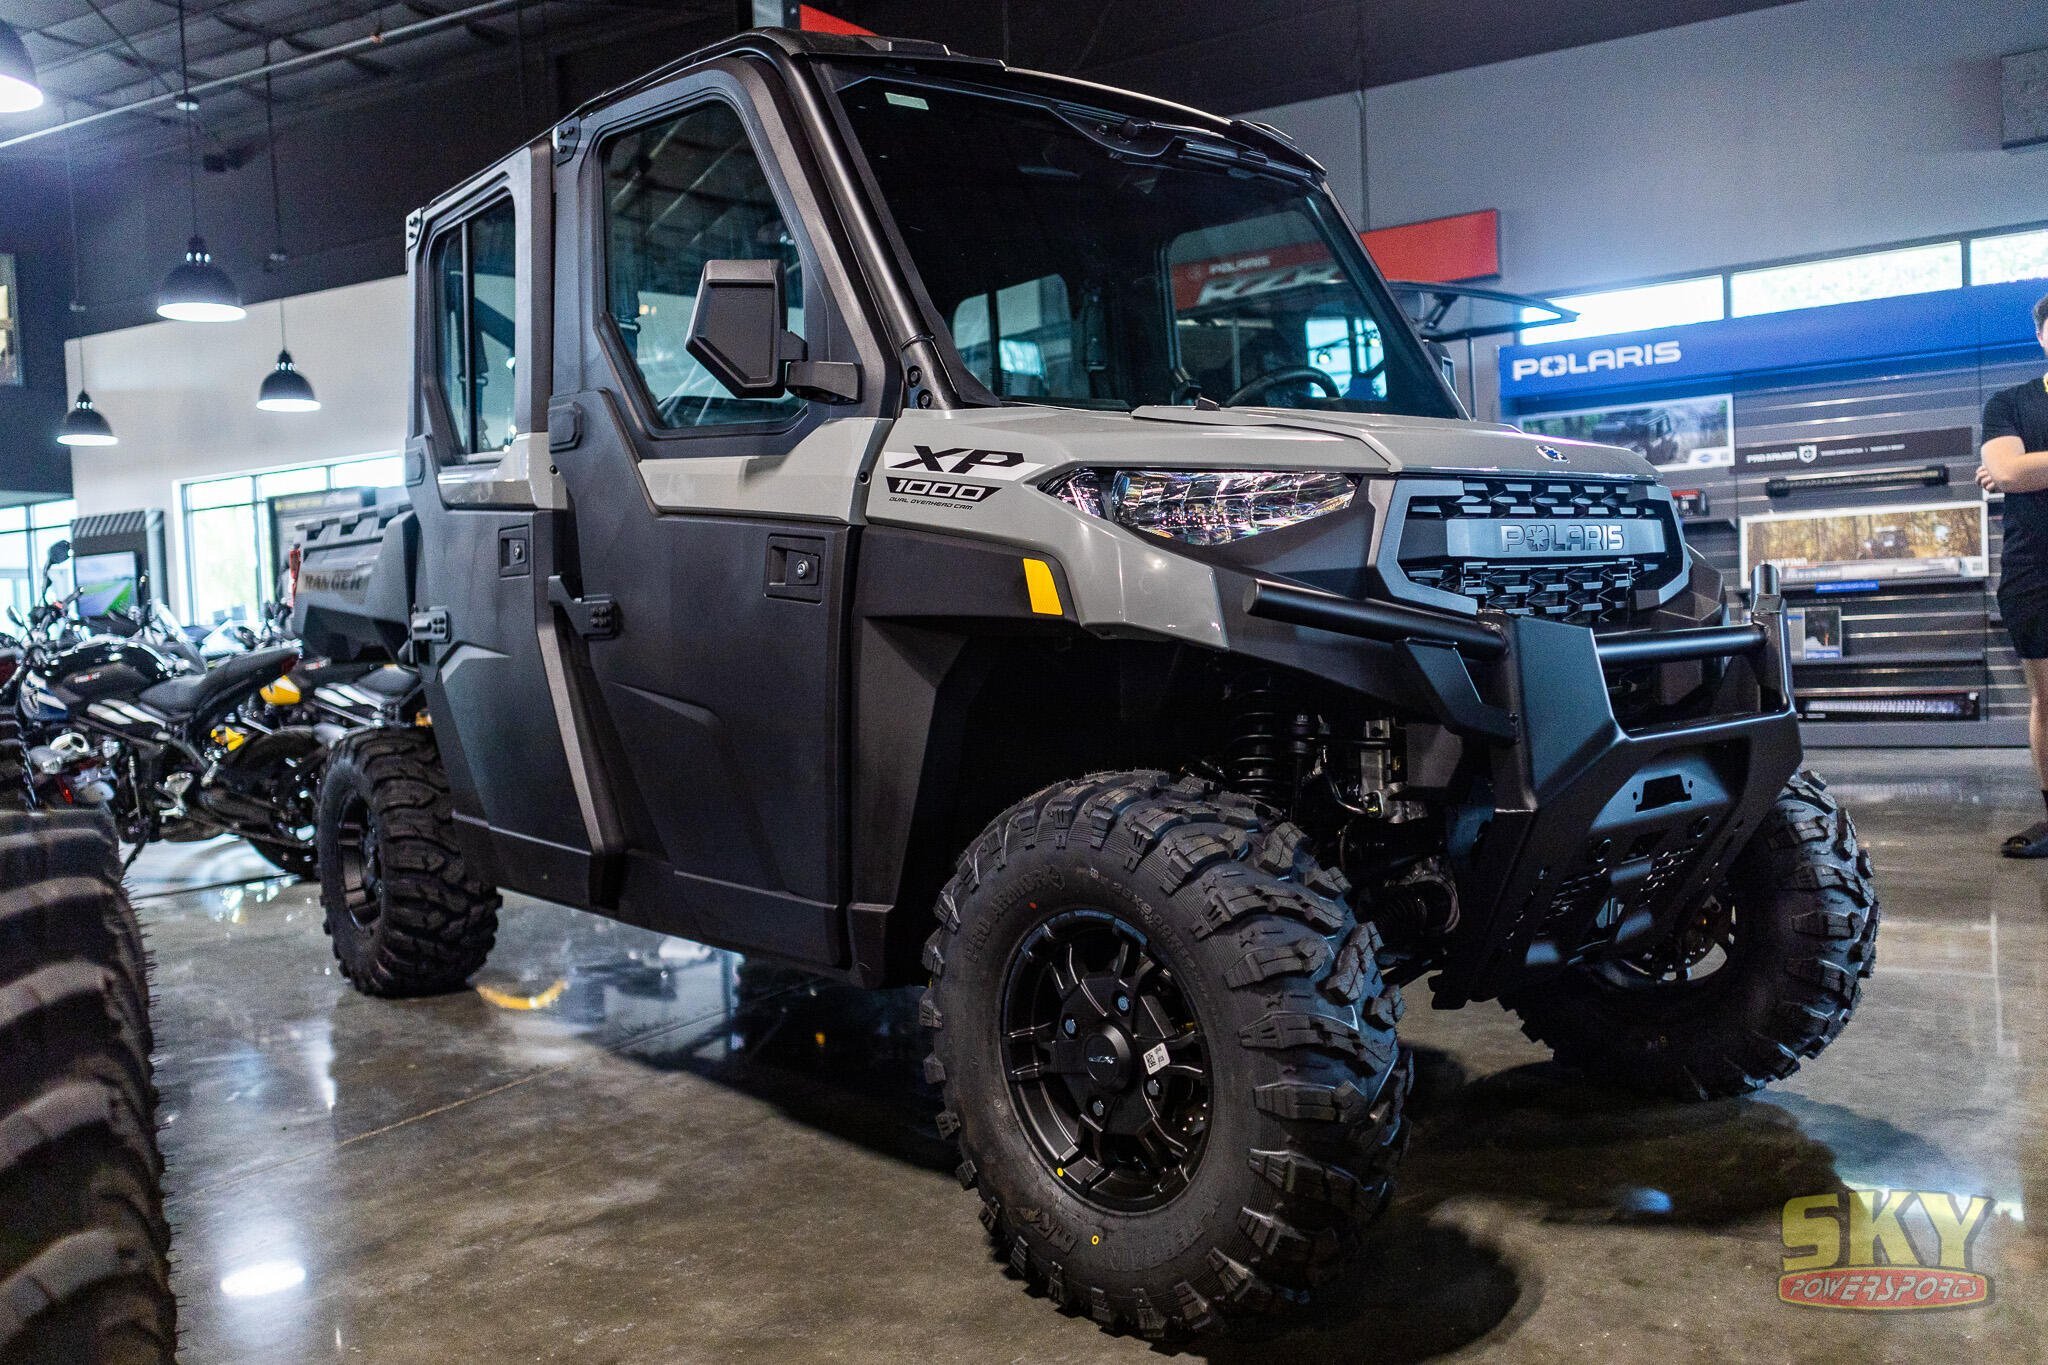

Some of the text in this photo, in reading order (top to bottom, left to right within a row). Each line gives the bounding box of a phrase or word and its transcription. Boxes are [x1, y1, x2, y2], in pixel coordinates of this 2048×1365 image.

[1512, 340, 1682, 381] POLARIS
[888, 444, 1025, 474] XP
[894, 479, 986, 500] 1000
[910, 499, 953, 509] OVERHEAD
[1500, 524, 1625, 552] POLARIS
